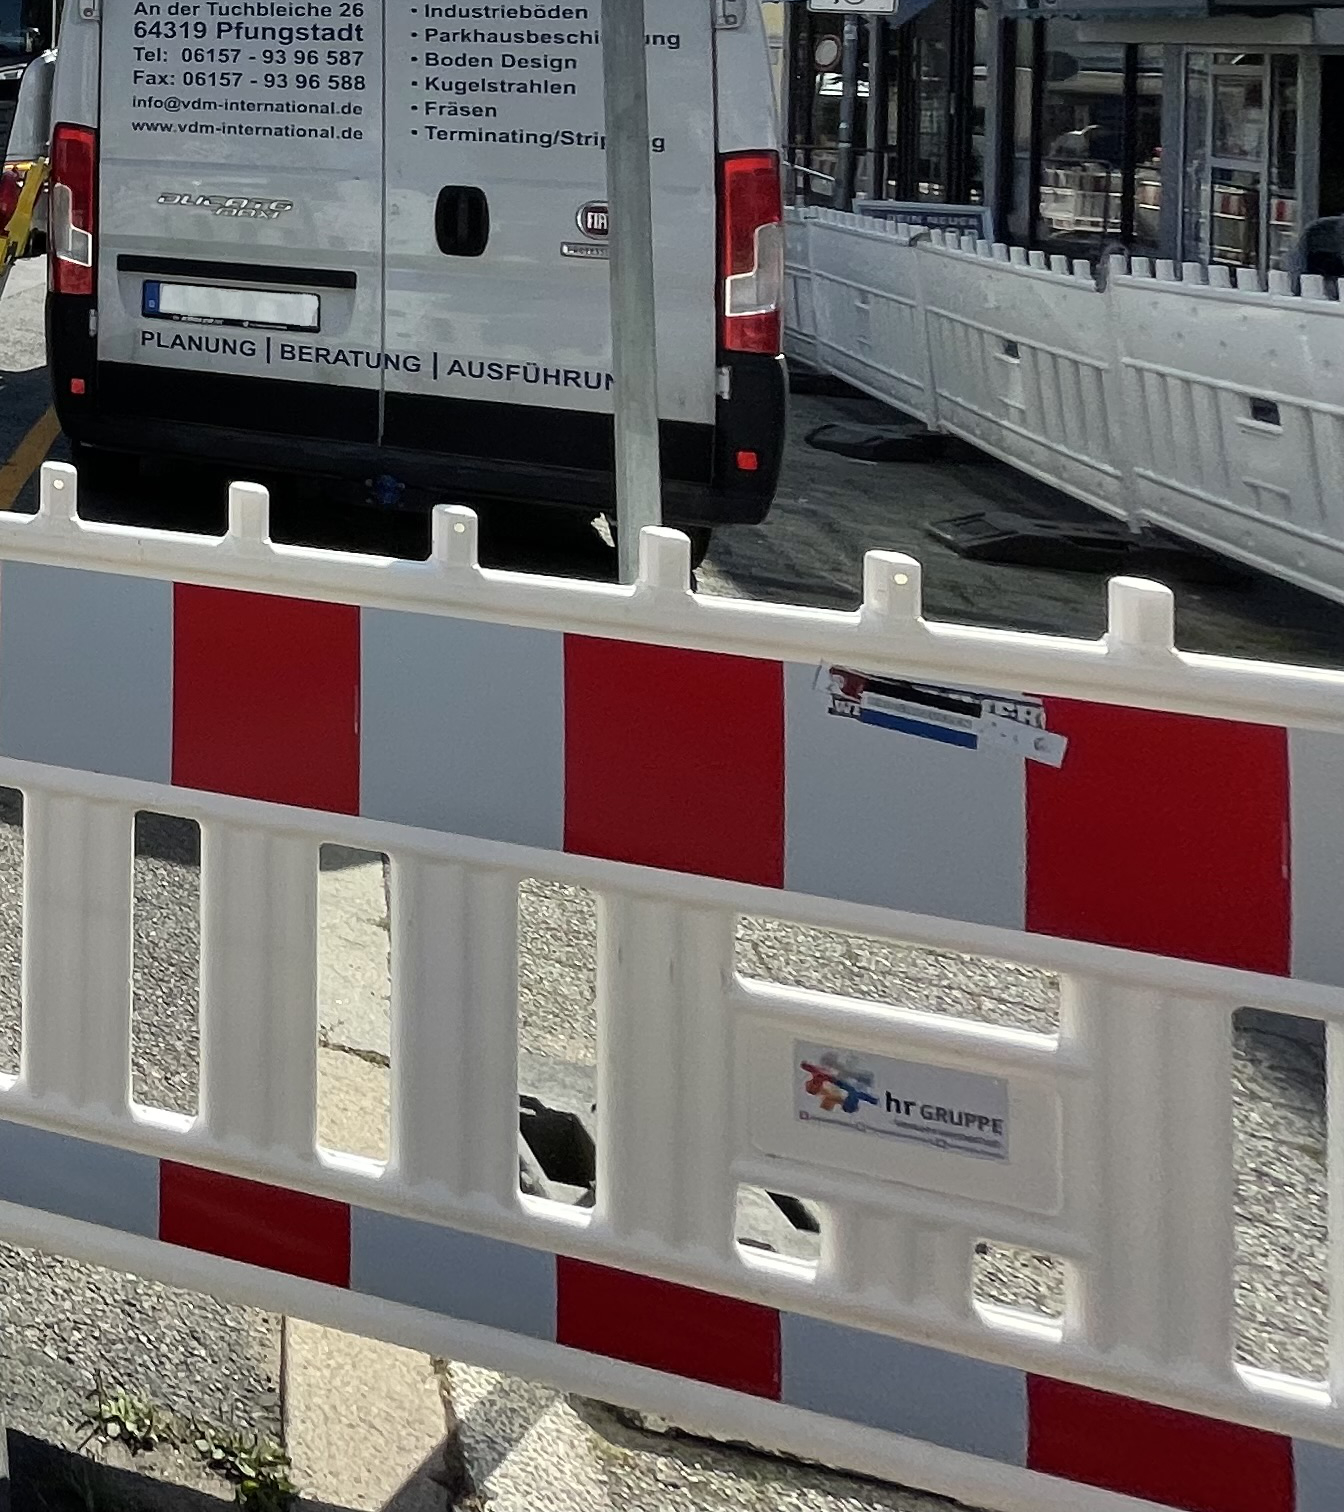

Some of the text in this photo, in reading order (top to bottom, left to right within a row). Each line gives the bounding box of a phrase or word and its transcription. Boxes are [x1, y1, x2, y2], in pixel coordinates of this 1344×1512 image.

[133, 1, 364, 18] An der Tuchbleiche 26
[424, 4, 589, 20] Industrieböden
[133, 20, 364, 46] 64319 Pfungstadt
[133, 46, 169, 63] Tel:
[181, 48, 242, 64] 06157
[262, 49, 287, 65] 93
[293, 50, 319, 66] 96
[325, 50, 365, 67] 587
[424, 51, 578, 73] Boden Design
[133, 69, 176, 86] Fax:
[182, 71, 244, 87] 06157
[263, 73, 288, 88] 93
[295, 74, 321, 90] 96
[327, 75, 367, 91] 588
[424, 76, 577, 95] Kugelstrahlen
[131, 95, 364, 116] info@vdm-international.de
[424, 101, 497, 118] Fräsen
[131, 120, 364, 141] www.vdm-international.de
[157, 191, 294, 211] DUCATO
[214, 206, 281, 220] MAXI
[586, 211, 609, 230] FIA
[141, 330, 256, 357] PLANUNG
[280, 343, 421, 373] BERATUNG
[447, 361, 617, 392] AUSFÜHRUN
[885, 1090, 917, 1116] hr
[920, 1104, 1005, 1136] GRUPPE
